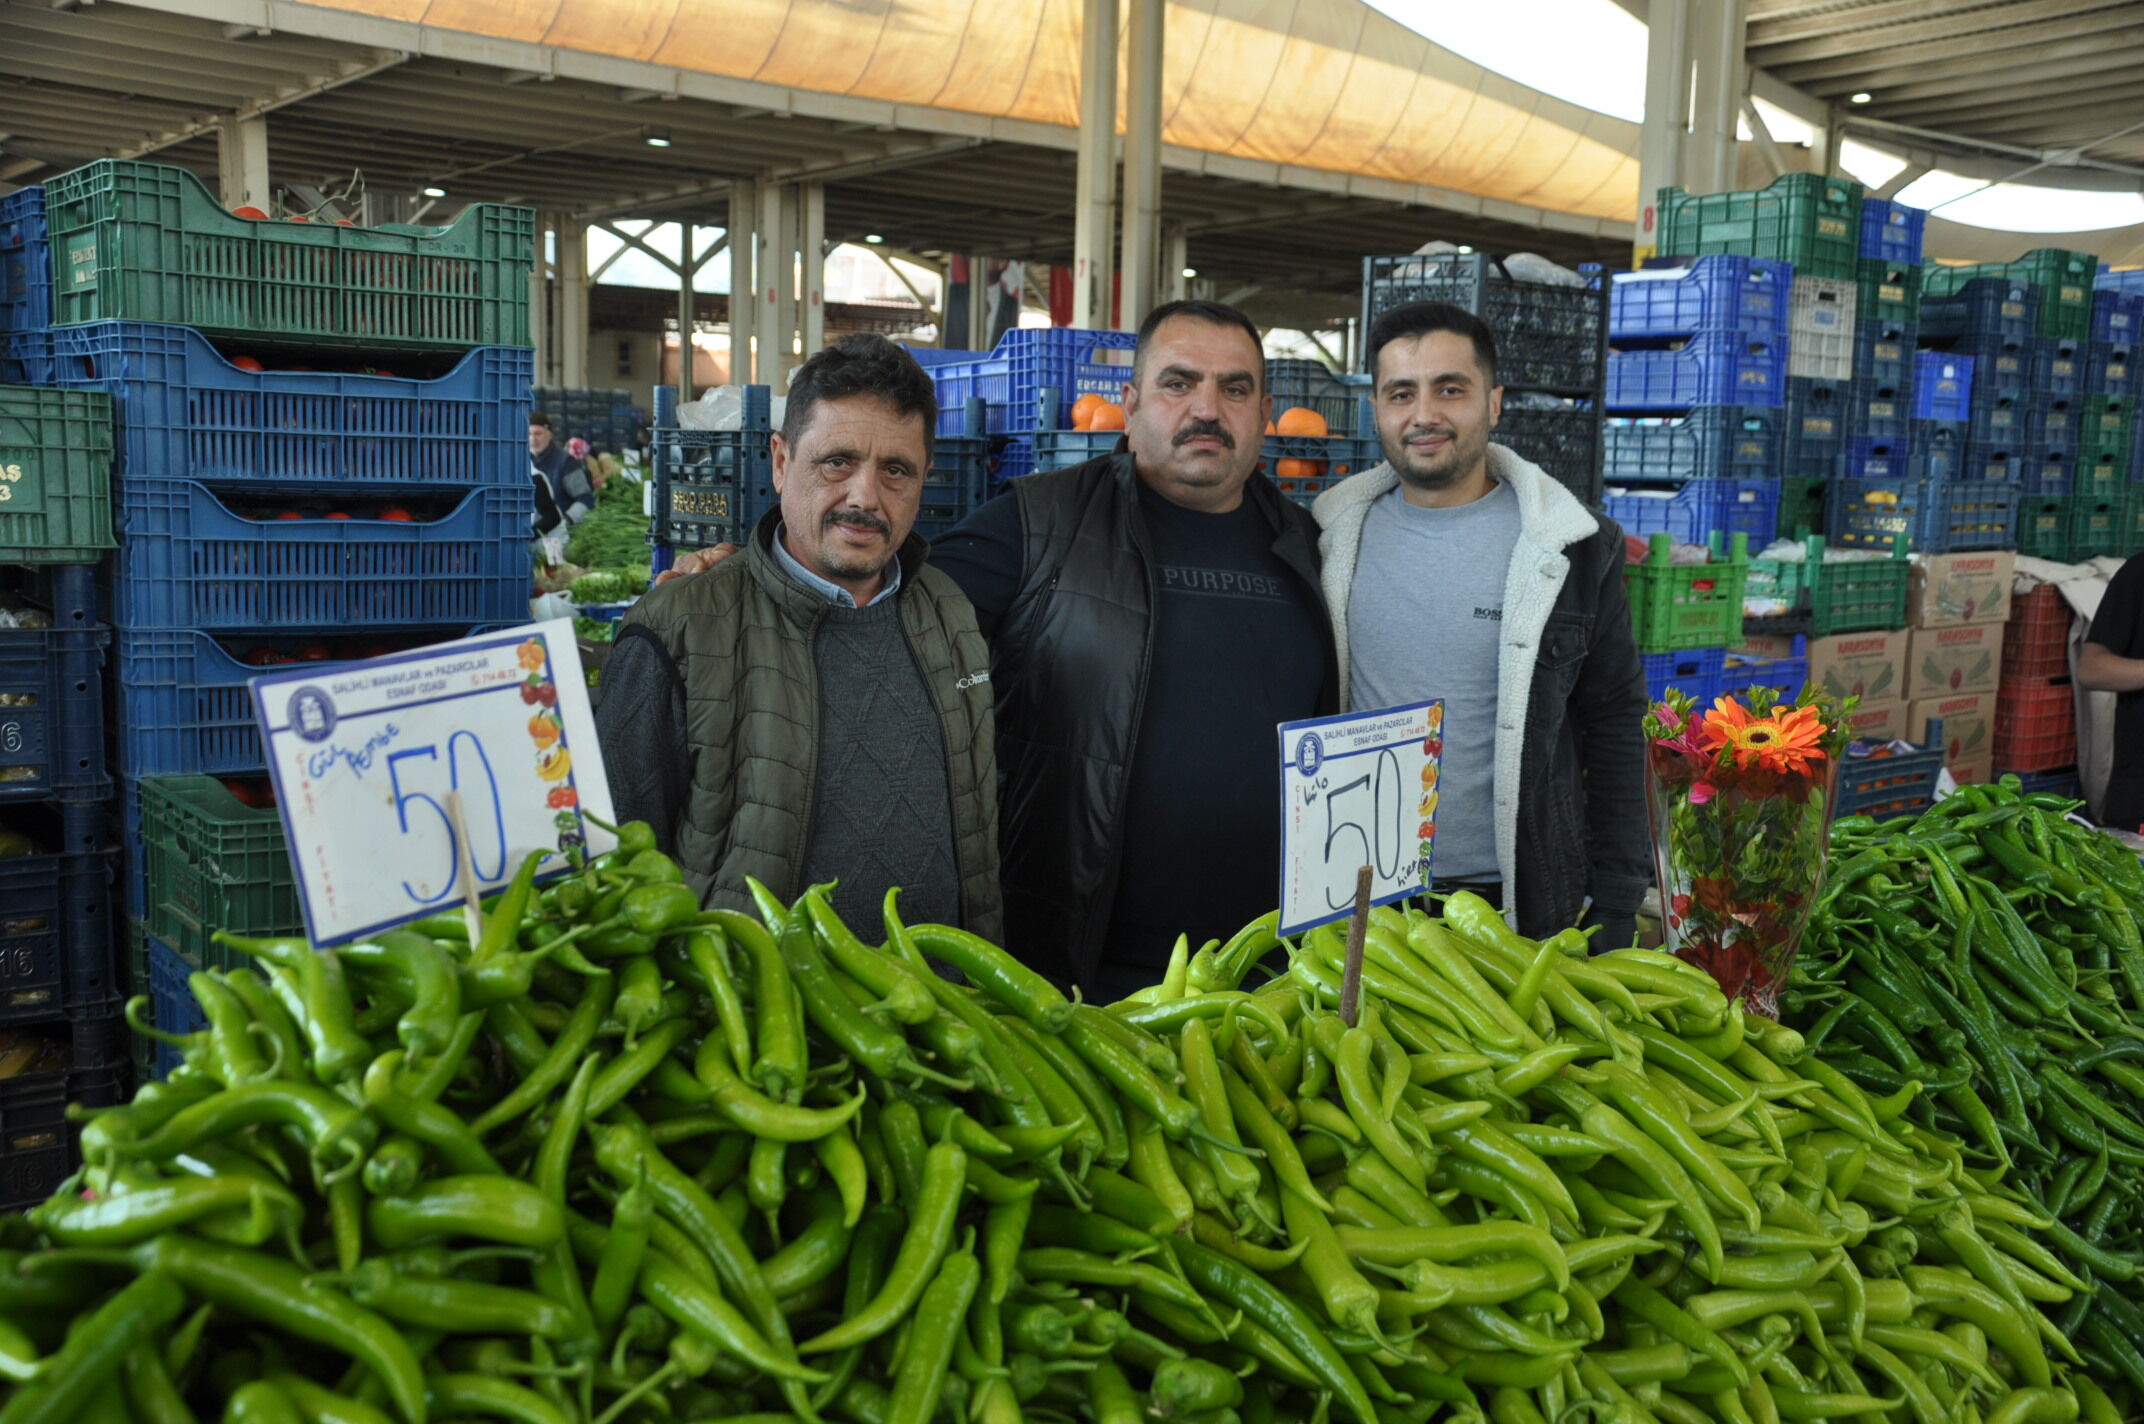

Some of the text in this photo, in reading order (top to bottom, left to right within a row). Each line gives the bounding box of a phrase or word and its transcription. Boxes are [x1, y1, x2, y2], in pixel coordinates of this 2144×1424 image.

[1643, 206, 1655, 232] 8
[1164, 568, 1281, 595] PURPOSE
[387, 730, 506, 903] 50
[1325, 749, 1401, 911] 50
